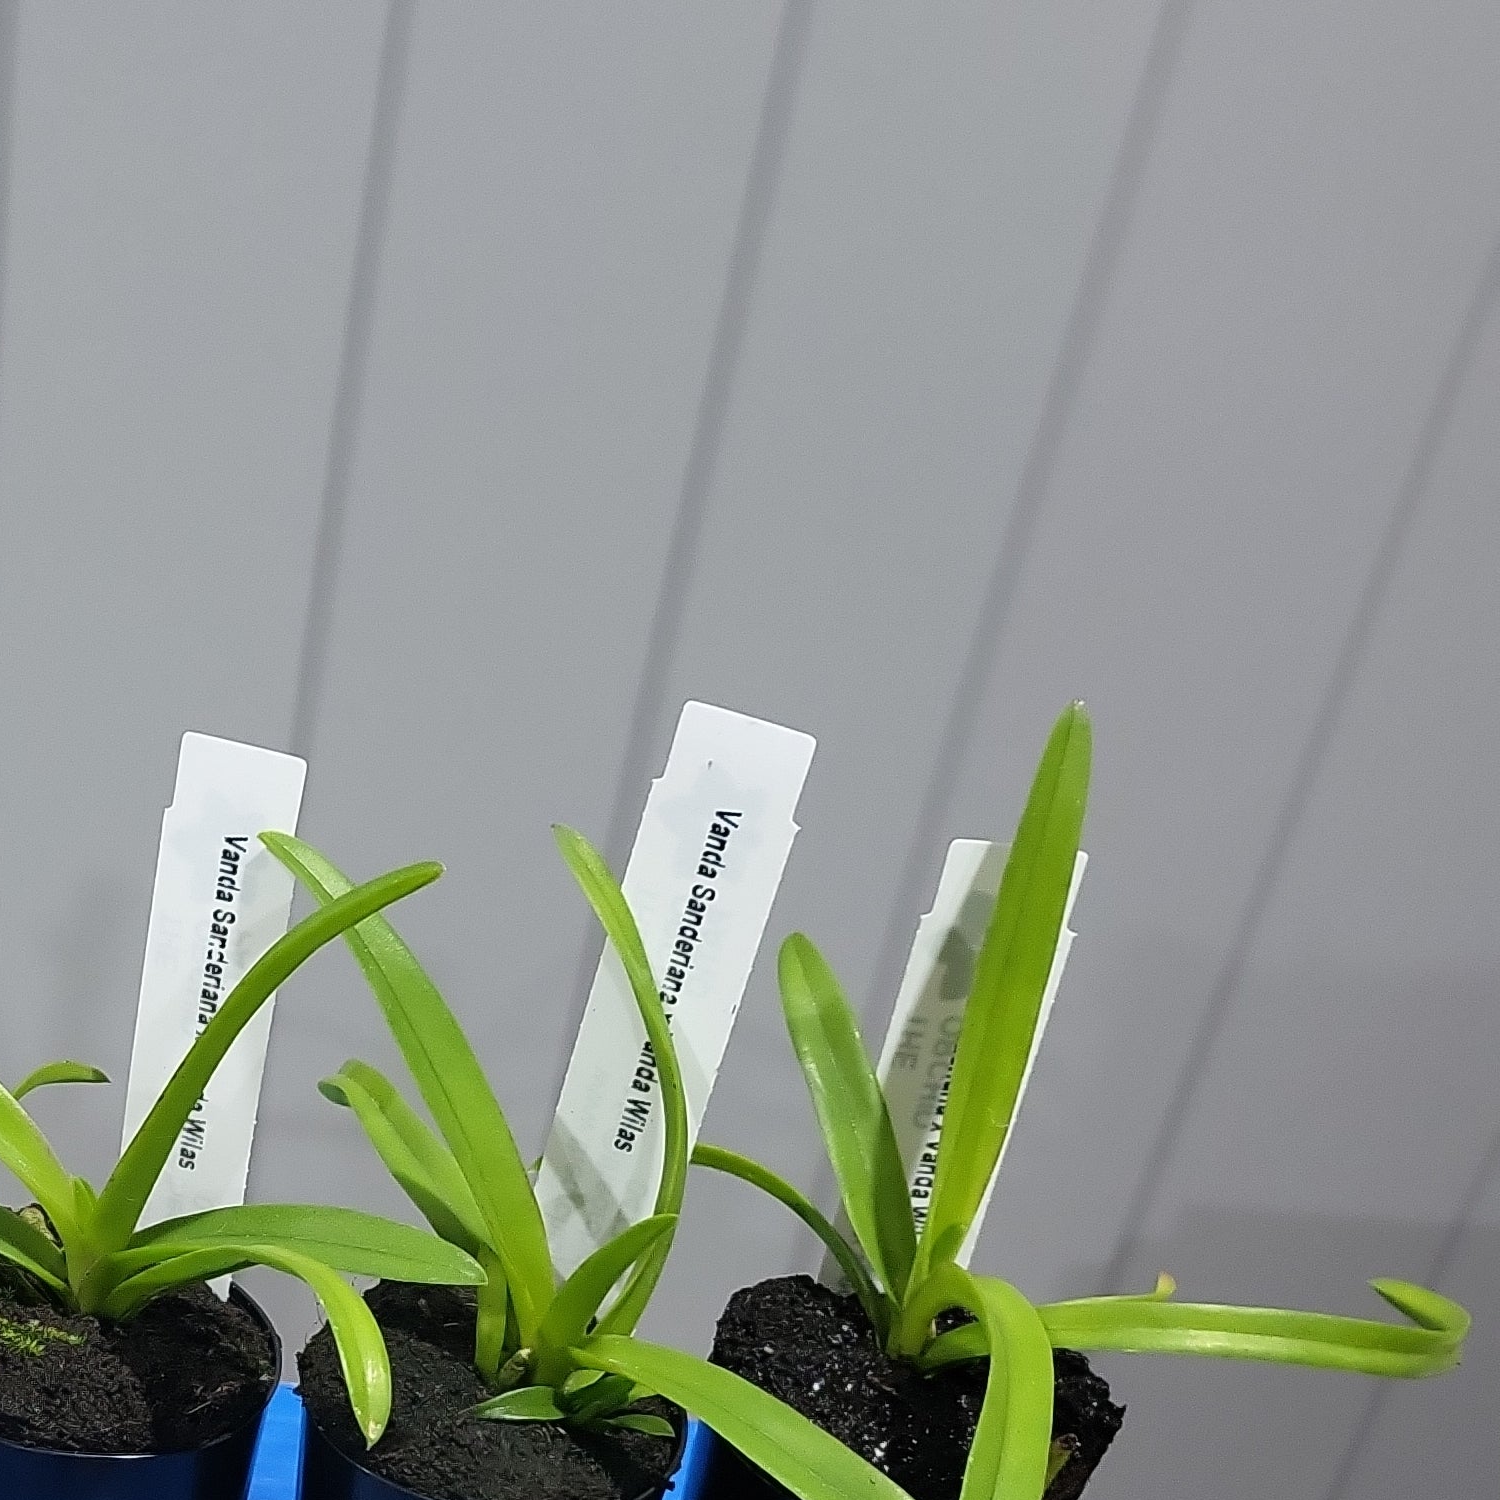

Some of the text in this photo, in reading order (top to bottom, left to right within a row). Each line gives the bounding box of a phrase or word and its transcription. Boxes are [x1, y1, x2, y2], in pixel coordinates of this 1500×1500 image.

[214, 836, 249, 903] Vanda
[695, 809, 743, 880] Vanda
[658, 884, 717, 1007] Sanderiana
[613, 1097, 652, 1153] Wilas
